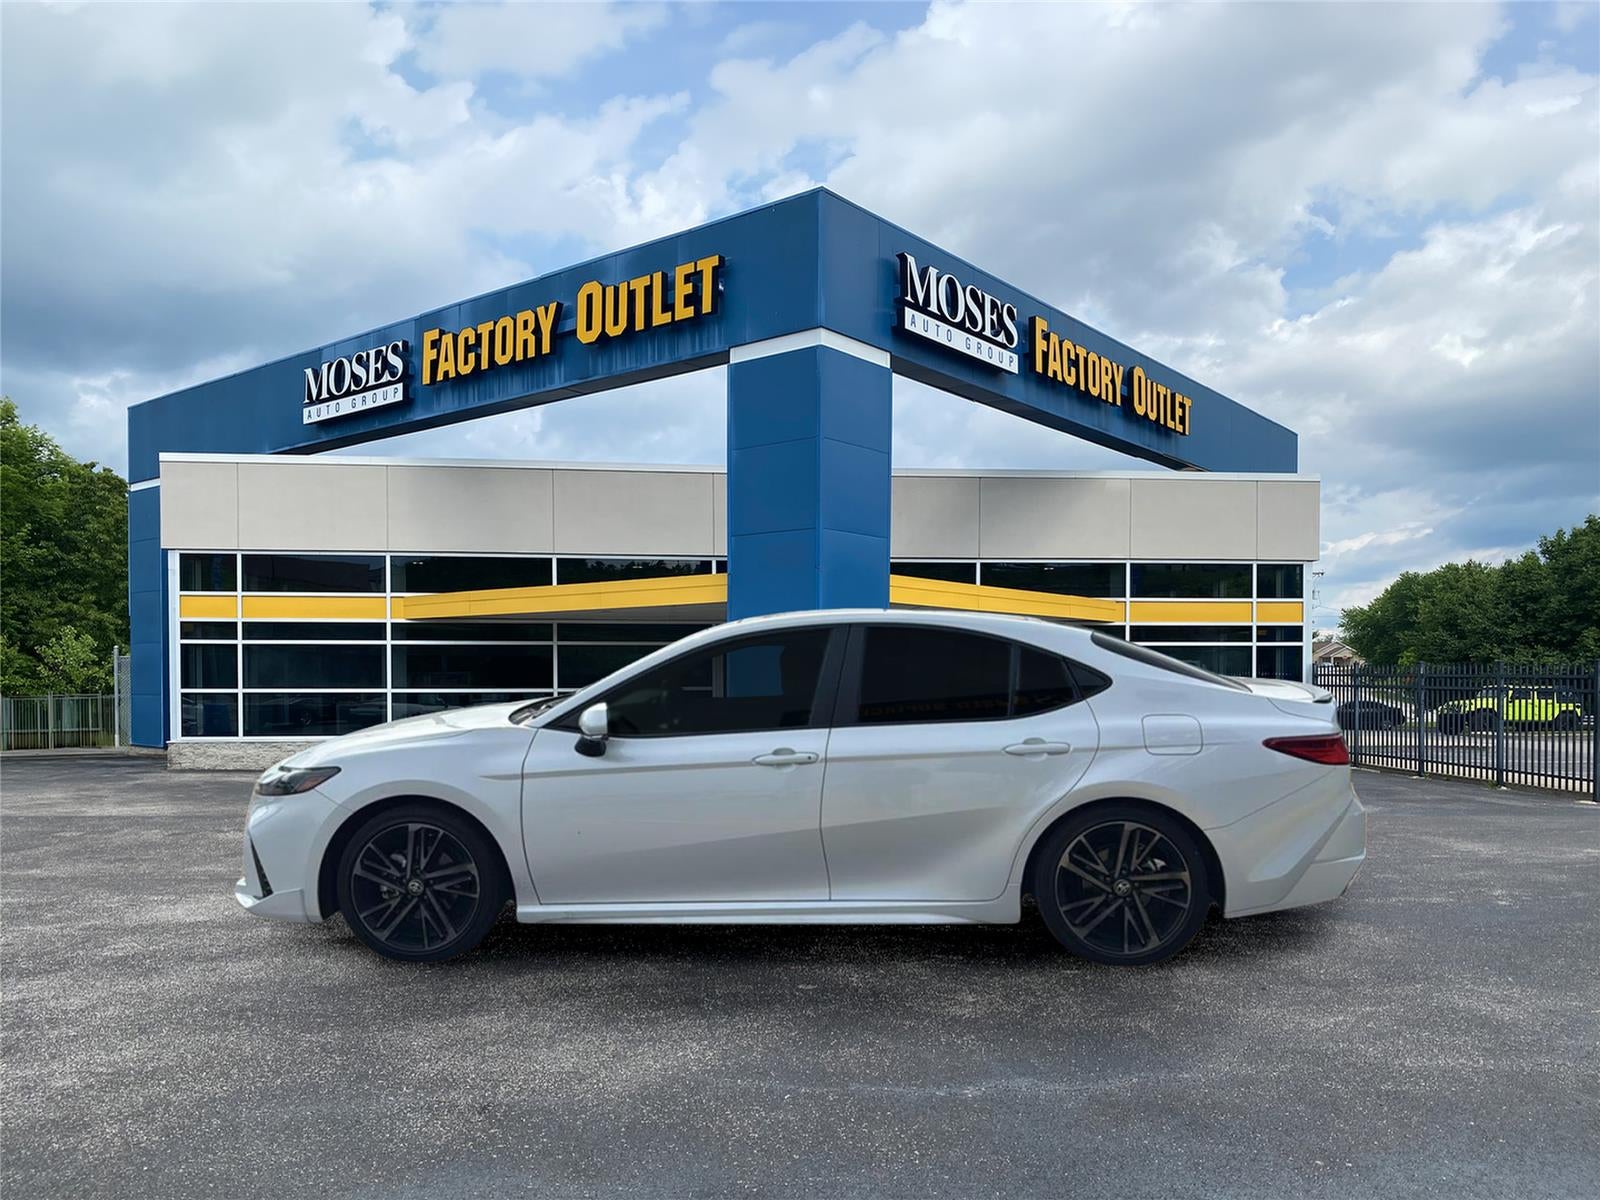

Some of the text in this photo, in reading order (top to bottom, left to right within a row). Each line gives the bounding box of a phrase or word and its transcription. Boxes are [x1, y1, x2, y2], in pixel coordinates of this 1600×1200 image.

[422, 254, 721, 386] FACTORY OUTLET
[903, 252, 1018, 349] MOSES
[910, 313, 1015, 367] AUTO GROUP
[303, 340, 404, 404] MOSES
[307, 388, 399, 421] AUTO GROUP
[1034, 315, 1192, 436] FACTORY OUTLET
